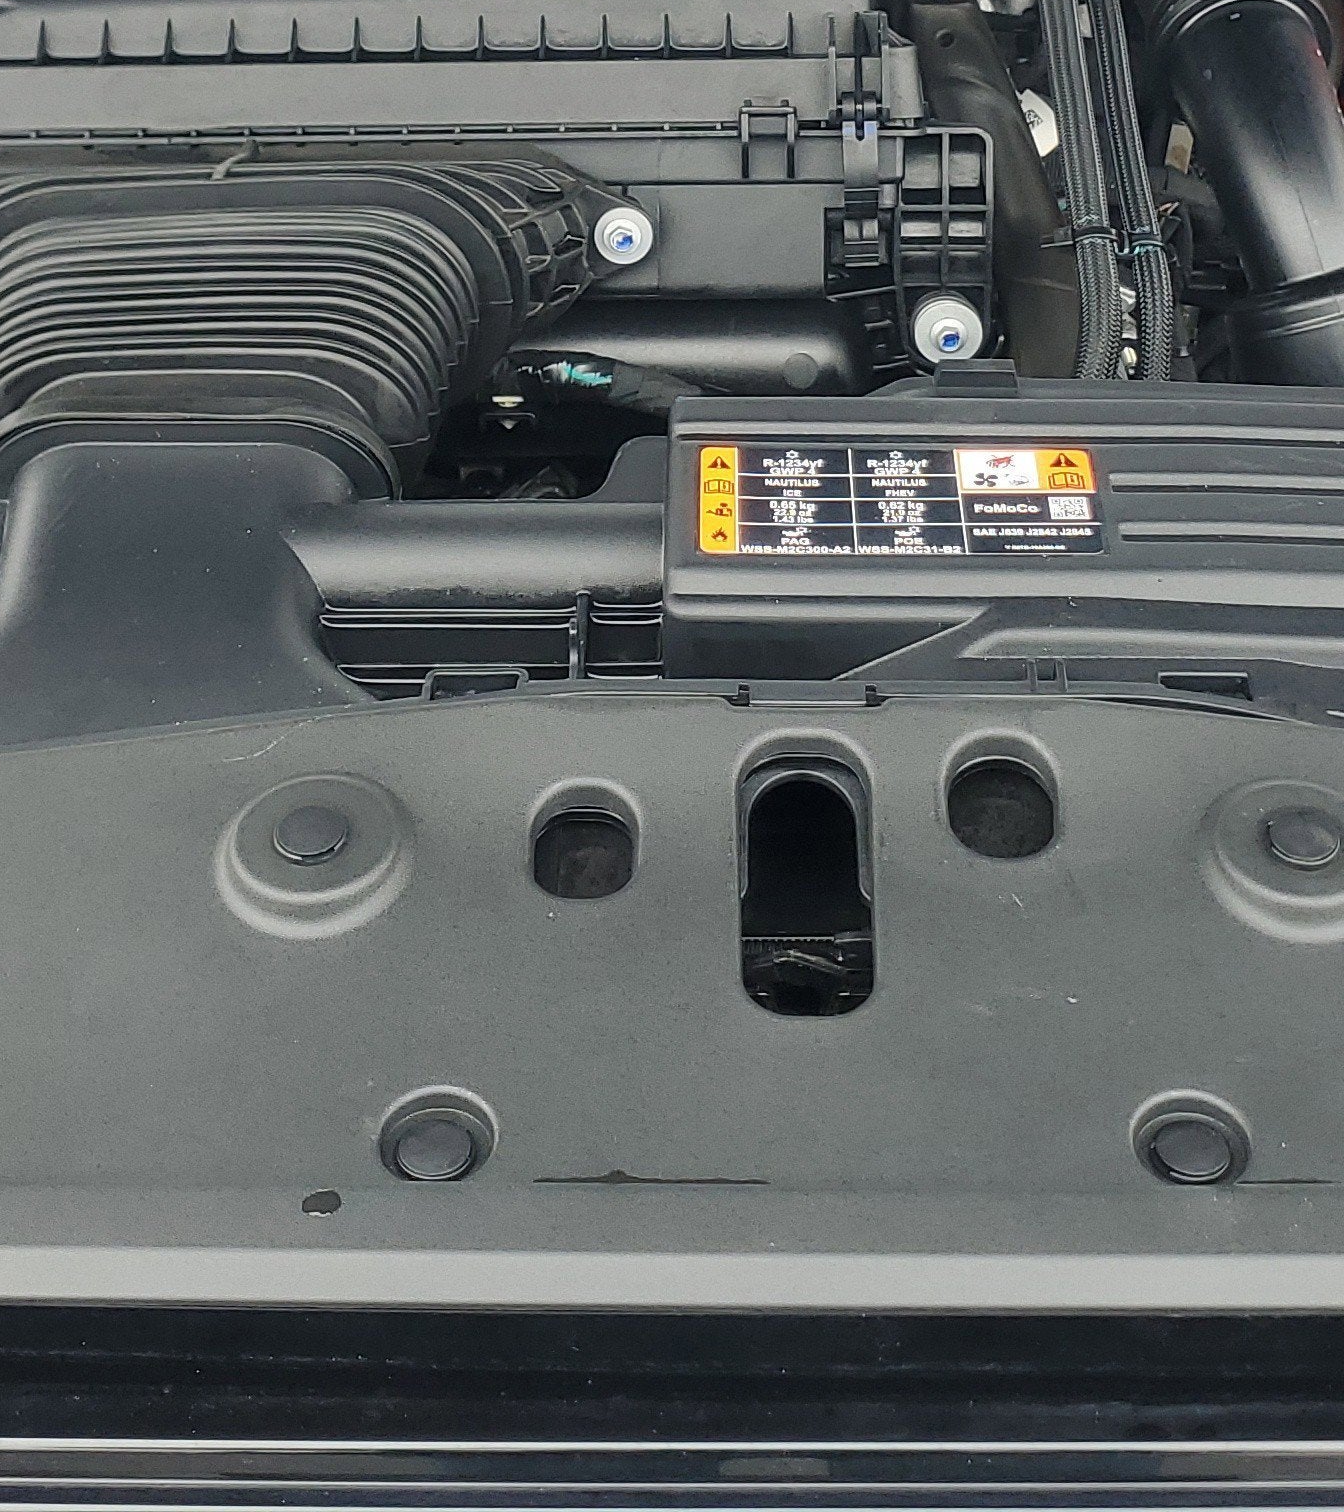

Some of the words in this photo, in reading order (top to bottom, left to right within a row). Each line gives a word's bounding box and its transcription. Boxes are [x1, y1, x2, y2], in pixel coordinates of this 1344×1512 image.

[762, 459, 824, 468] R-1234yf
[866, 459, 928, 468] R-1234yf
[769, 467, 804, 475] GWP
[807, 467, 816, 475] 4
[873, 467, 909, 475] GWP
[764, 479, 821, 487] NAUTILUS
[871, 479, 928, 487] NAUTILUS
[884, 489, 915, 497] FHEV
[799, 501, 816, 511] kg
[907, 501, 925, 511] kg
[973, 503, 1040, 514] FoMoCo
[972, 528, 998, 536] SAE
